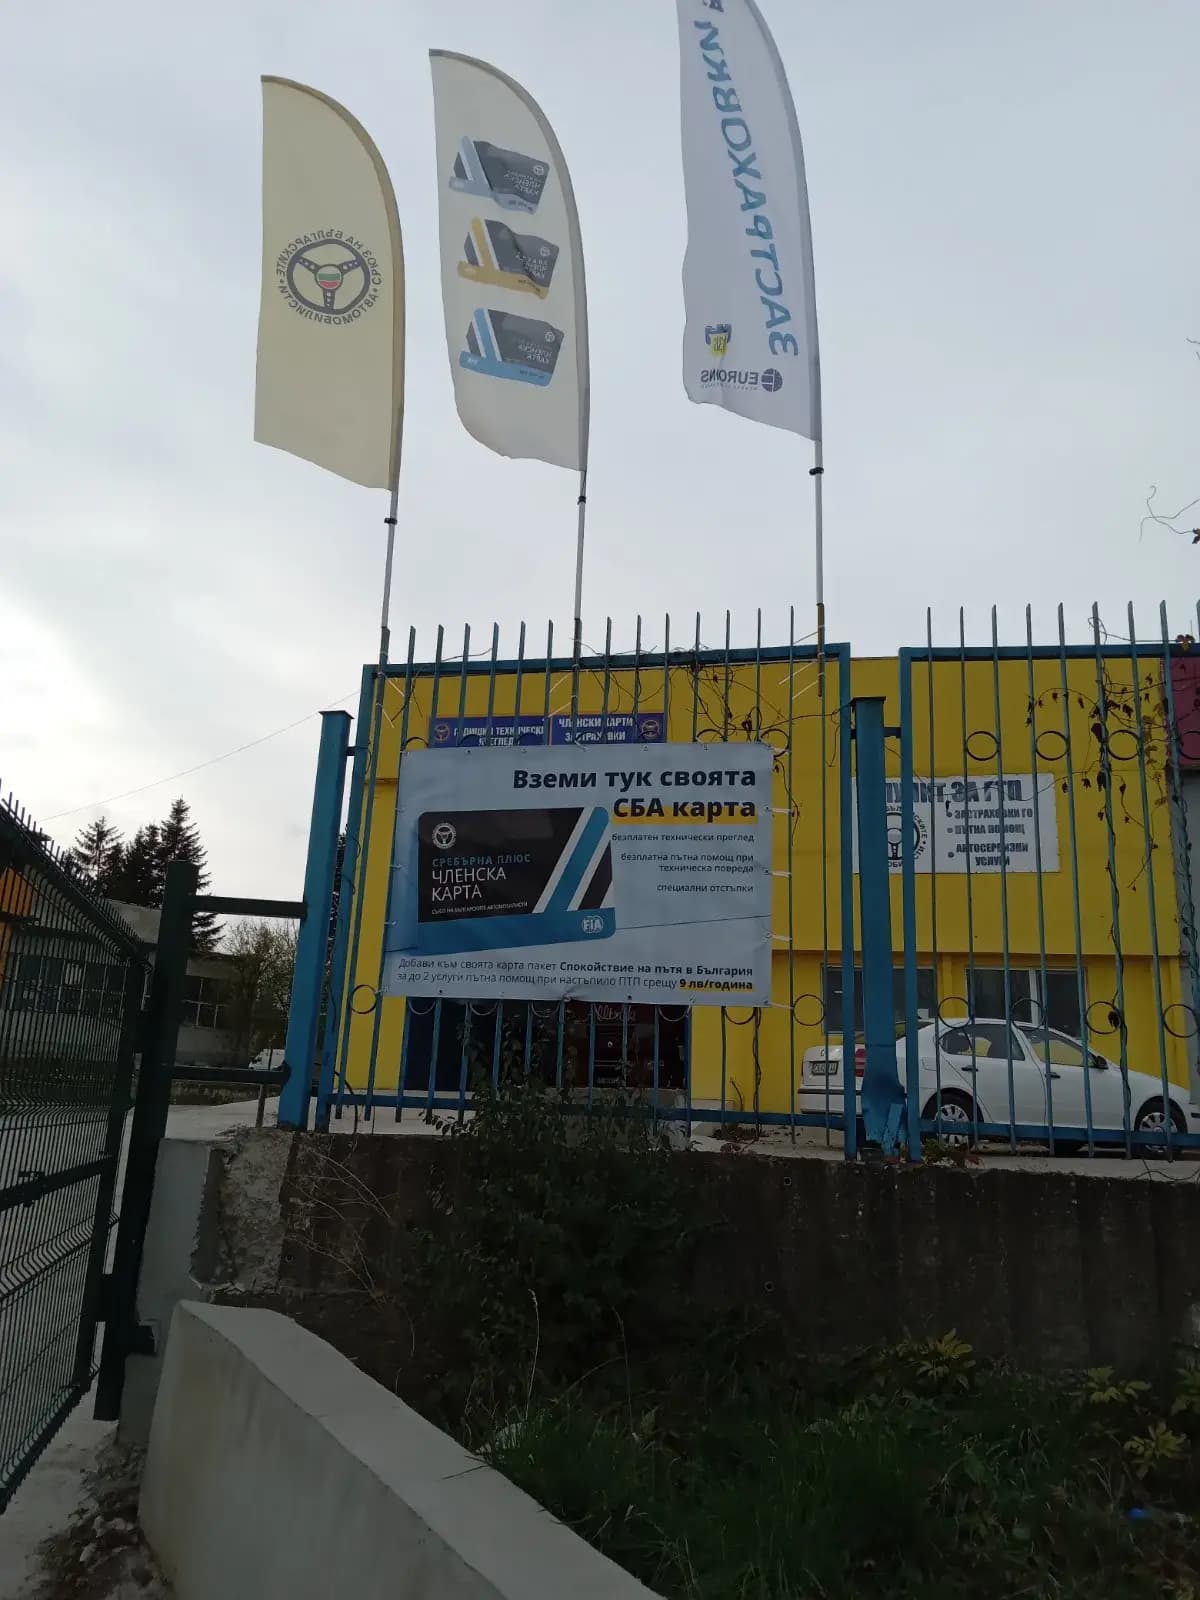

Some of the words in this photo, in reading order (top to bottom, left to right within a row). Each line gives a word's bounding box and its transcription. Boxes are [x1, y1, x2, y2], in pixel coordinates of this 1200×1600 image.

[559, 717, 601, 728] ЧЛНСКИ
[513, 769, 597, 789] Вземи
[604, 771, 653, 792] тук
[660, 770, 756, 787] своята
[613, 797, 665, 818] СБА
[672, 801, 756, 824] карта
[611, 833, 659, 842] безплатен
[661, 834, 714, 842] технически
[716, 834, 755, 843] преглед
[432, 855, 493, 867] СРЕБЪРНА
[497, 854, 531, 864] ПЛЮС
[620, 853, 668, 861] безплатна
[700, 854, 734, 862] помощ
[736, 854, 754, 864] при
[975, 856, 1010, 866] УСЛУИ
[432, 866, 507, 884] ЧЛЕНСКА
[658, 864, 712, 872] техническа
[714, 865, 754, 874] повреда
[431, 884, 482, 902] КАРТА
[656, 884, 708, 893] специални
[709, 884, 754, 893] отстъпки
[398, 958, 435, 969] Добави
[437, 960, 458, 969] към
[460, 961, 494, 970] своята
[496, 962, 525, 972] карта
[527, 963, 557, 971] пакет
[559, 961, 634, 973] Спокойствие
[637, 964, 651, 973] на
[654, 965, 682, 974] пътя
[686, 966, 693, 975] в
[696, 965, 753, 978] България
[408, 972, 422, 982] до
[423, 971, 429, 981] 2
[431, 973, 463, 984] услуги
[465, 974, 497, 983] пътна
[499, 975, 535, 985] помощ
[537, 976, 557, 986] при
[559, 977, 616, 987] настъпило
[618, 976, 641, 987] ПТП
[643, 979, 678, 989] срещу
[679, 978, 686, 988] 9
[688, 978, 753, 991] лв/година
